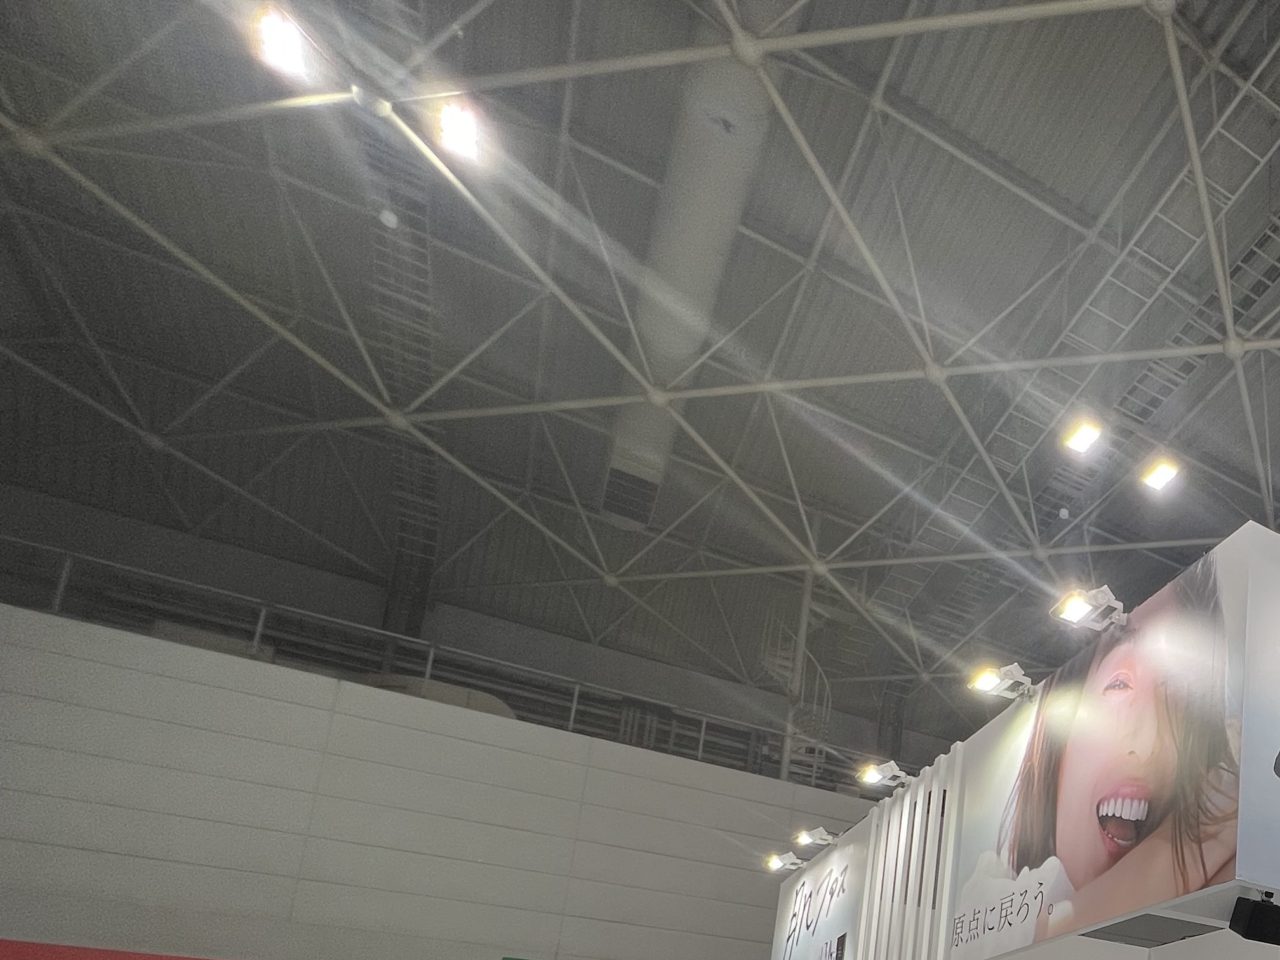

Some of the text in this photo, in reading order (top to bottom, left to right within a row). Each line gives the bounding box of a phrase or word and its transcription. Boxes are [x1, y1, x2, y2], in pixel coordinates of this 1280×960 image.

[952, 882, 1054, 948] 原点に戻ろう。
